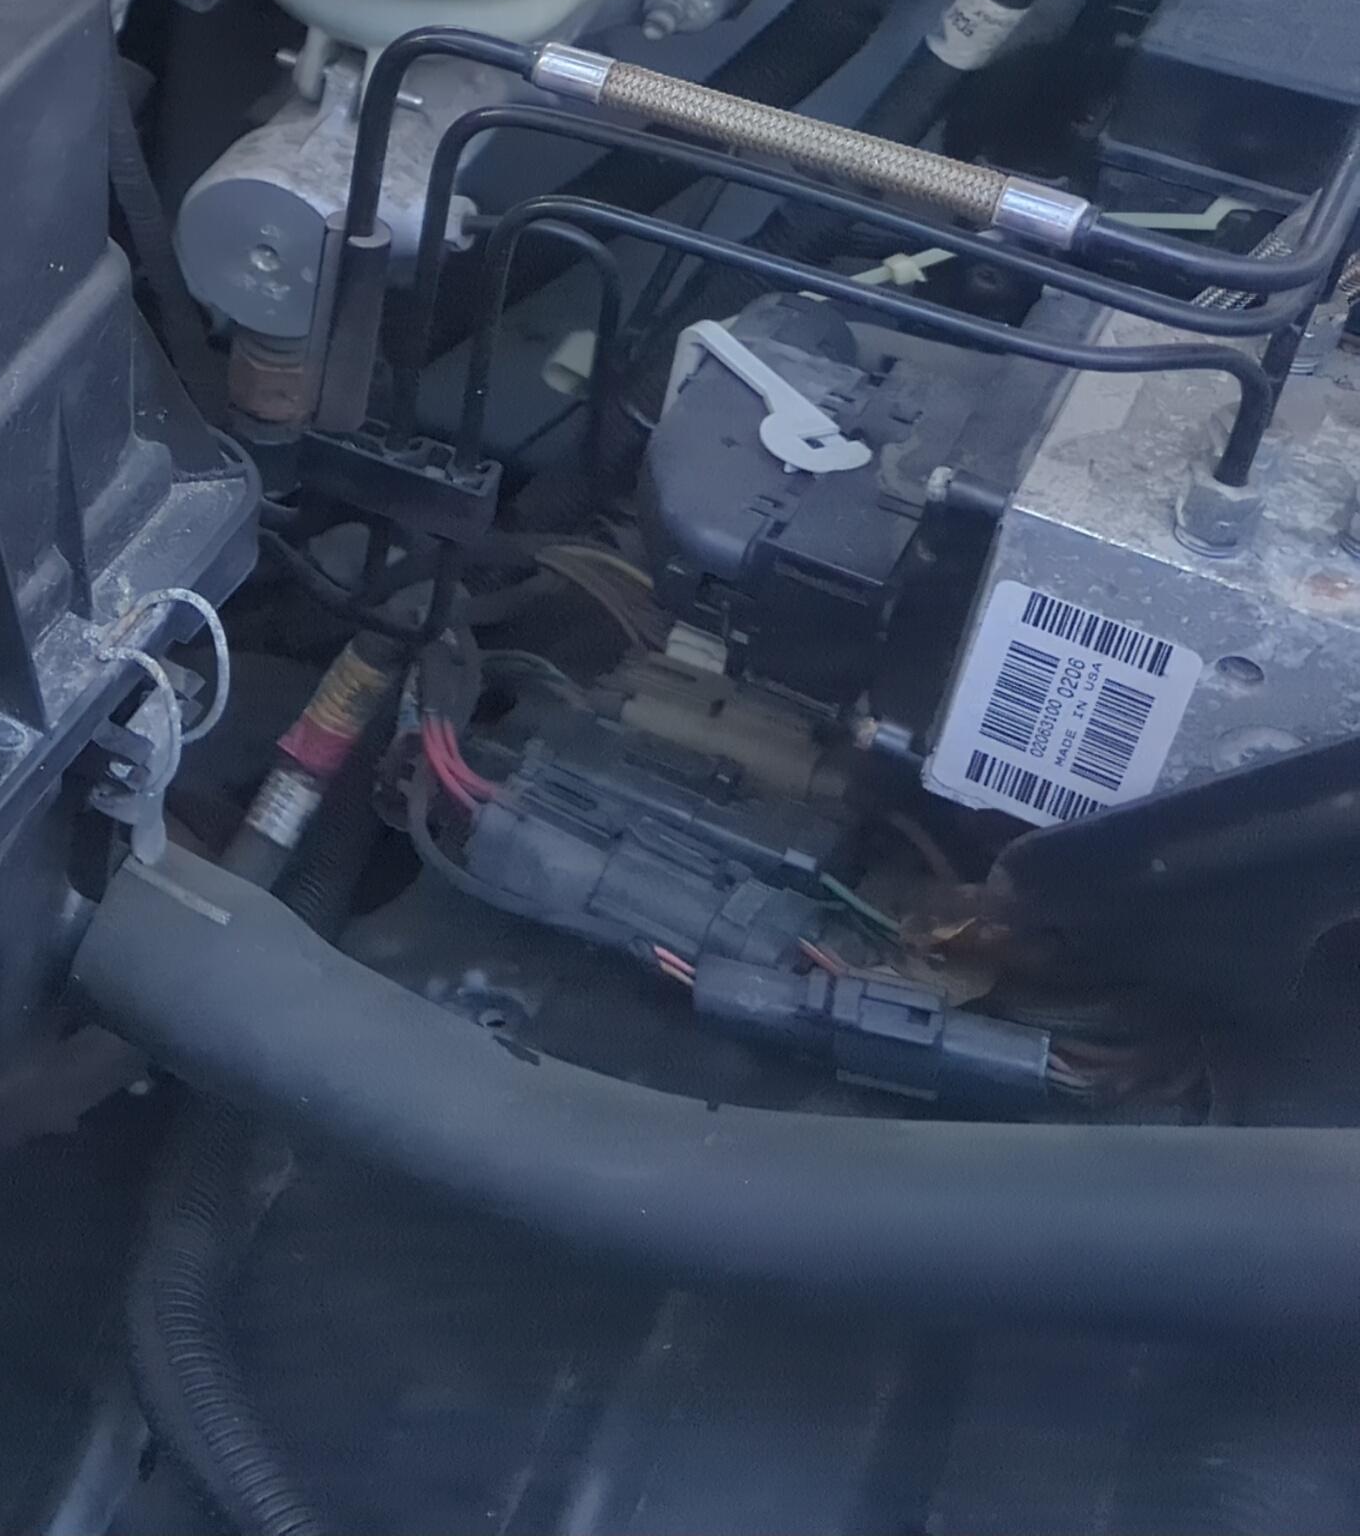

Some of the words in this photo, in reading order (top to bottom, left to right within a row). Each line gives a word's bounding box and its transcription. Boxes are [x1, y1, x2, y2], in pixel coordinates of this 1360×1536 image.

[1030, 698, 1062, 759] 02063100
[1057, 657, 1086, 699] 0206
[1054, 729, 1077, 767] MADE
[1073, 701, 1088, 719] IN
[1084, 662, 1102, 691] USA
